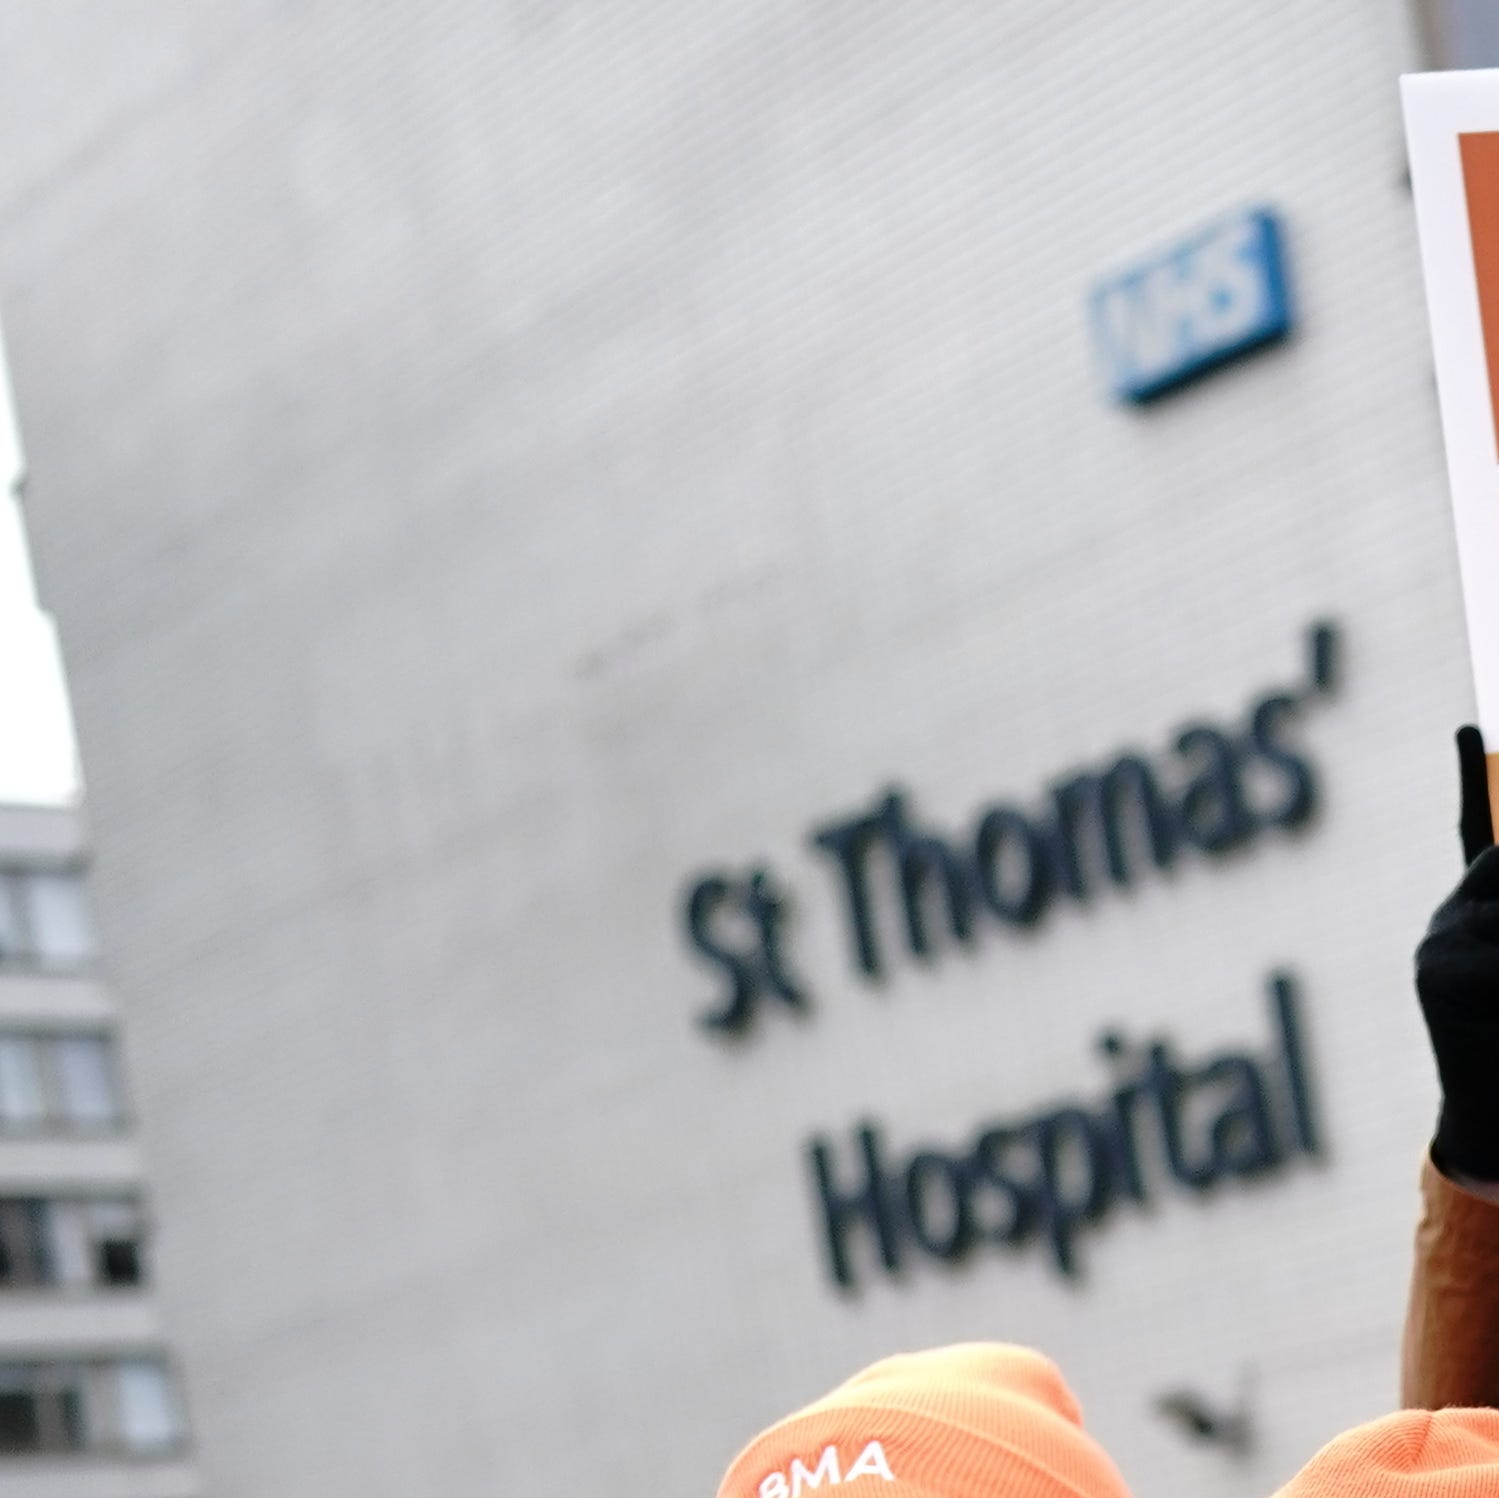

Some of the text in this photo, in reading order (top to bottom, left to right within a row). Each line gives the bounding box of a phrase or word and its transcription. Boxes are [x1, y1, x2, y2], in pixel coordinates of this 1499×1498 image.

[1103, 212, 1263, 375] NHS
[682, 622, 1341, 1043] St Thomas'
[808, 965, 1324, 1295] Hospital
